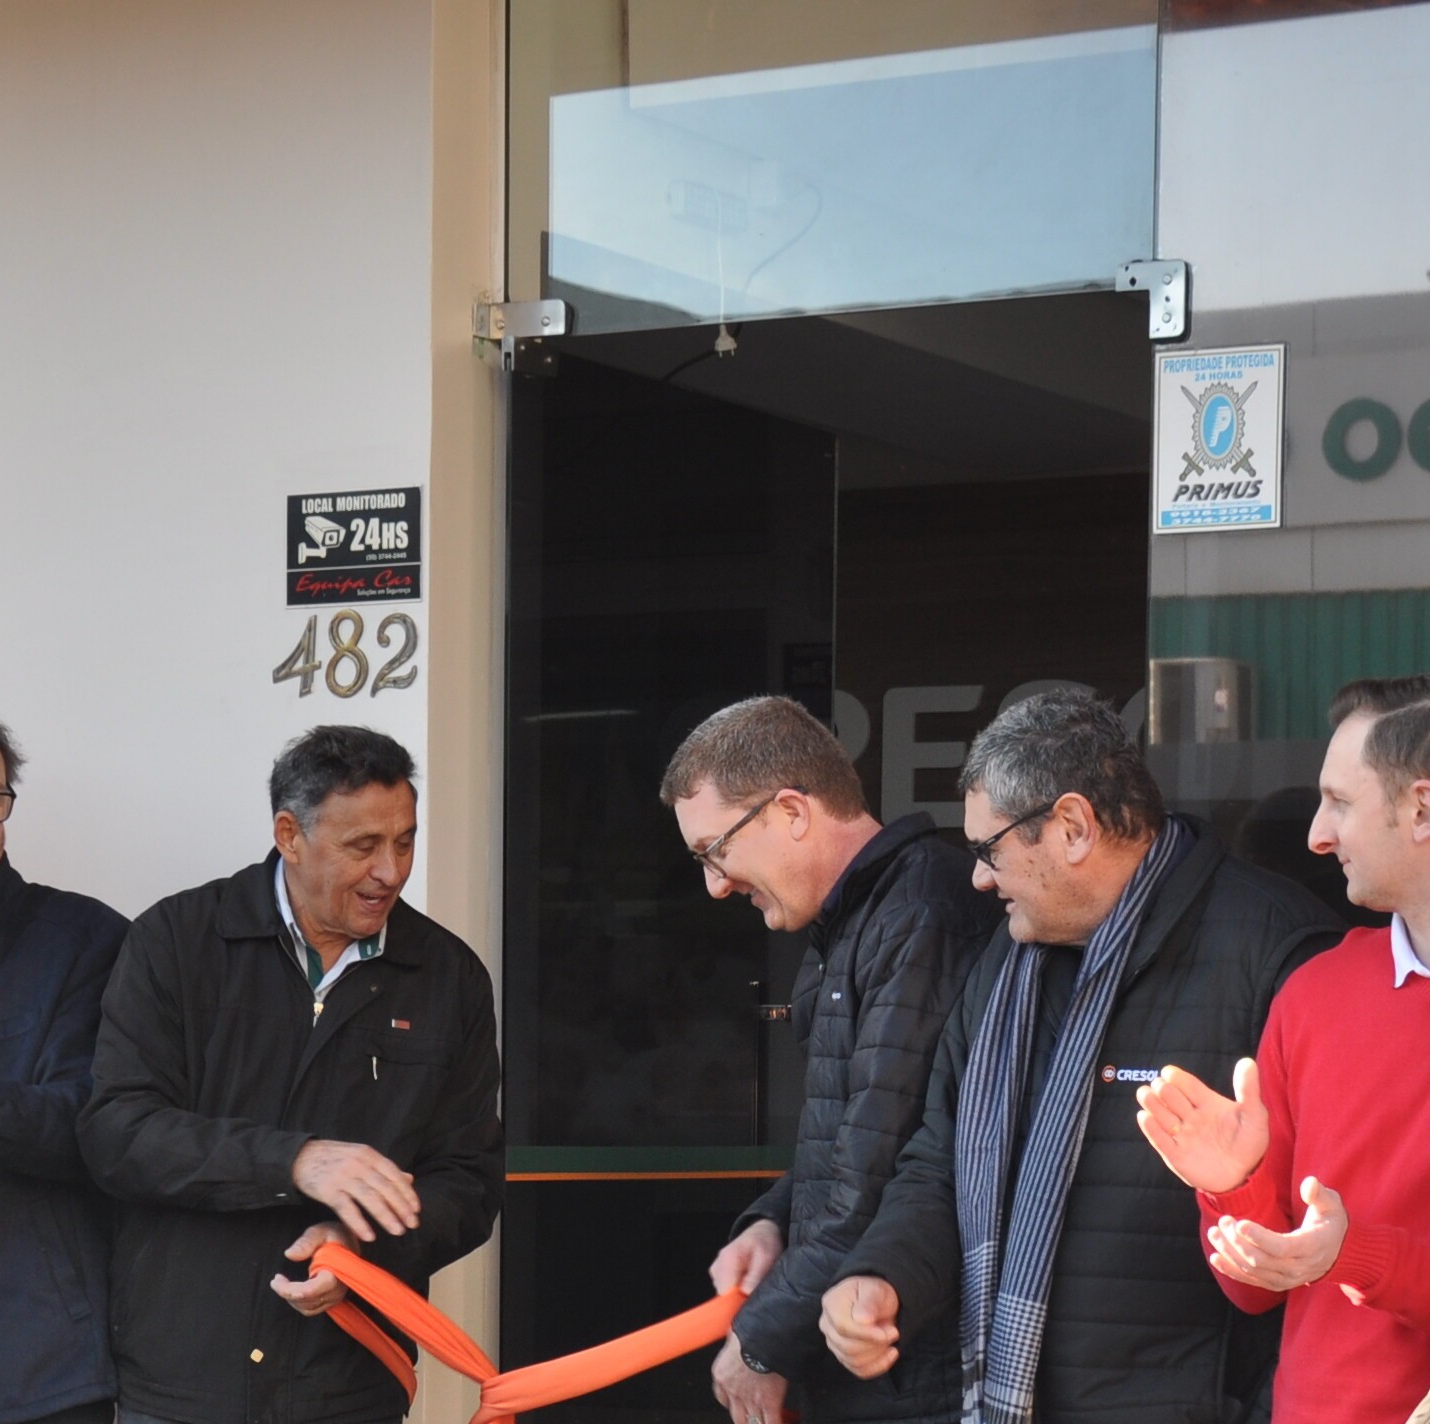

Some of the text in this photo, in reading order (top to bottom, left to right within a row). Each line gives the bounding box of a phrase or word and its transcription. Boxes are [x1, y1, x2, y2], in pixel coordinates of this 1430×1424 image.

[1163, 353, 1275, 373] PROPRIEDADE PROTEGIDA
[1195, 371, 1243, 382] 24 HORAS
[1172, 480, 1263, 502] PRIMUS
[301, 492, 406, 514] LOCAL MONITORADO
[350, 517, 409, 551] 24HS
[272, 608, 418, 699] 482
